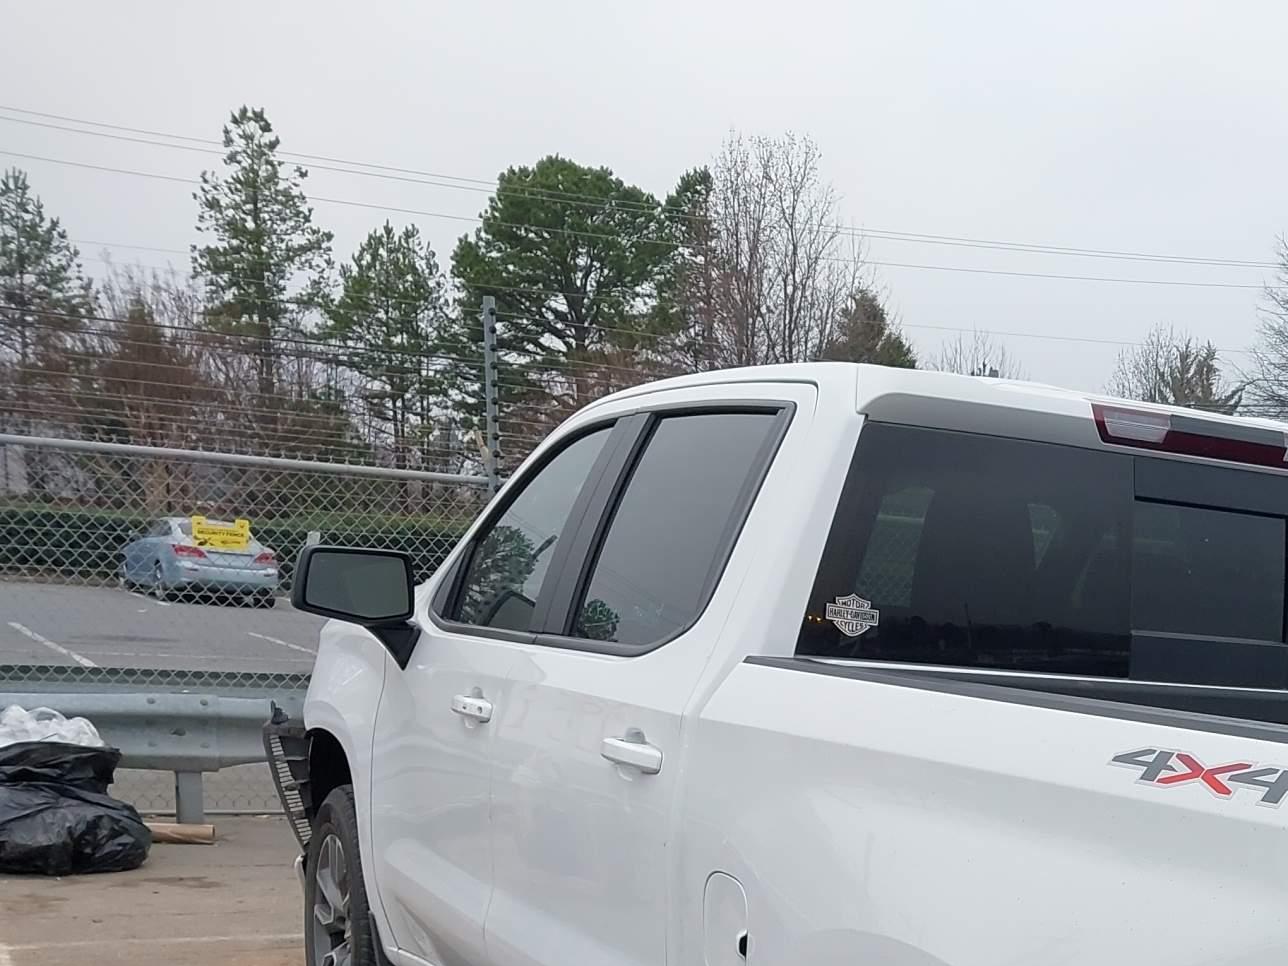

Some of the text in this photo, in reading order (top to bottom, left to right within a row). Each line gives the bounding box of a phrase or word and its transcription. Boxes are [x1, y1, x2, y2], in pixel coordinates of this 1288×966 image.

[840, 599, 869, 609] MOTOR
[828, 607, 877, 622] HARLEY-DAVIDSON
[838, 620, 867, 633] CYCLES
